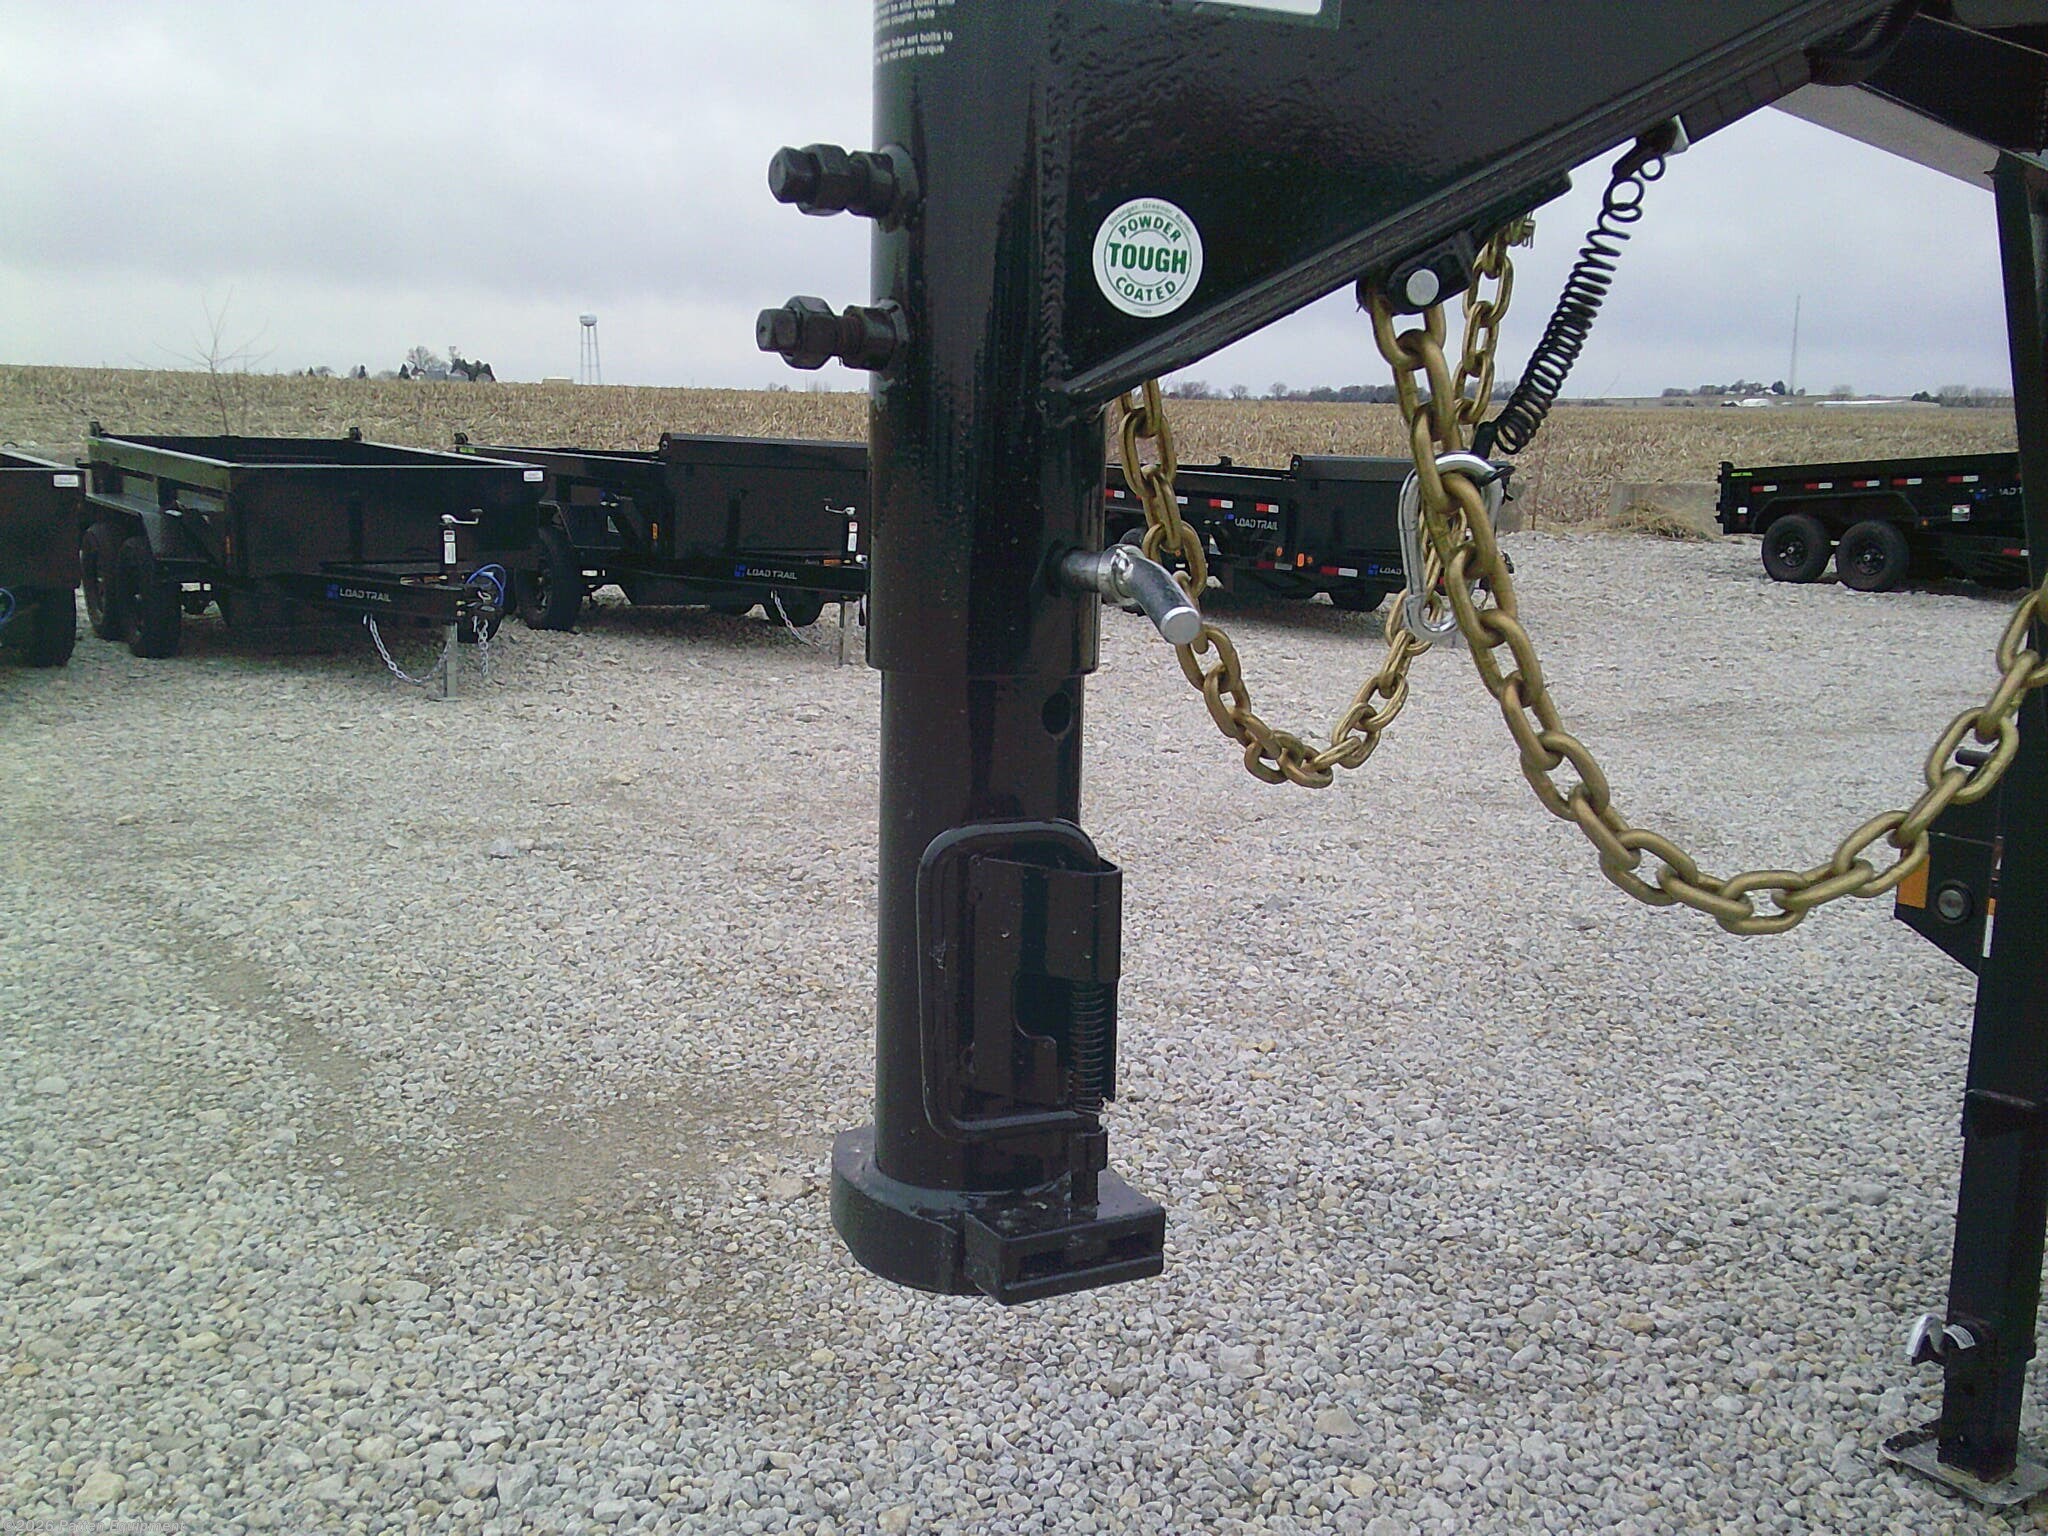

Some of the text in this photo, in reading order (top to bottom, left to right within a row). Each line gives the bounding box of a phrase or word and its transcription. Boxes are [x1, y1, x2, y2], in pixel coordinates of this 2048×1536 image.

[943, 30, 953, 41] to
[917, 44, 945, 56] torque
[1118, 215, 1182, 243] POWDER
[1108, 242, 1188, 275] TOUGH
[1115, 276, 1176, 302] COATED
[1234, 518, 1278, 531] LOAD TRAIL
[747, 568, 798, 580] LOAD TRAIL
[1379, 567, 1402, 575] LOAD
[339, 587, 392, 603] LOAD TRAIL
